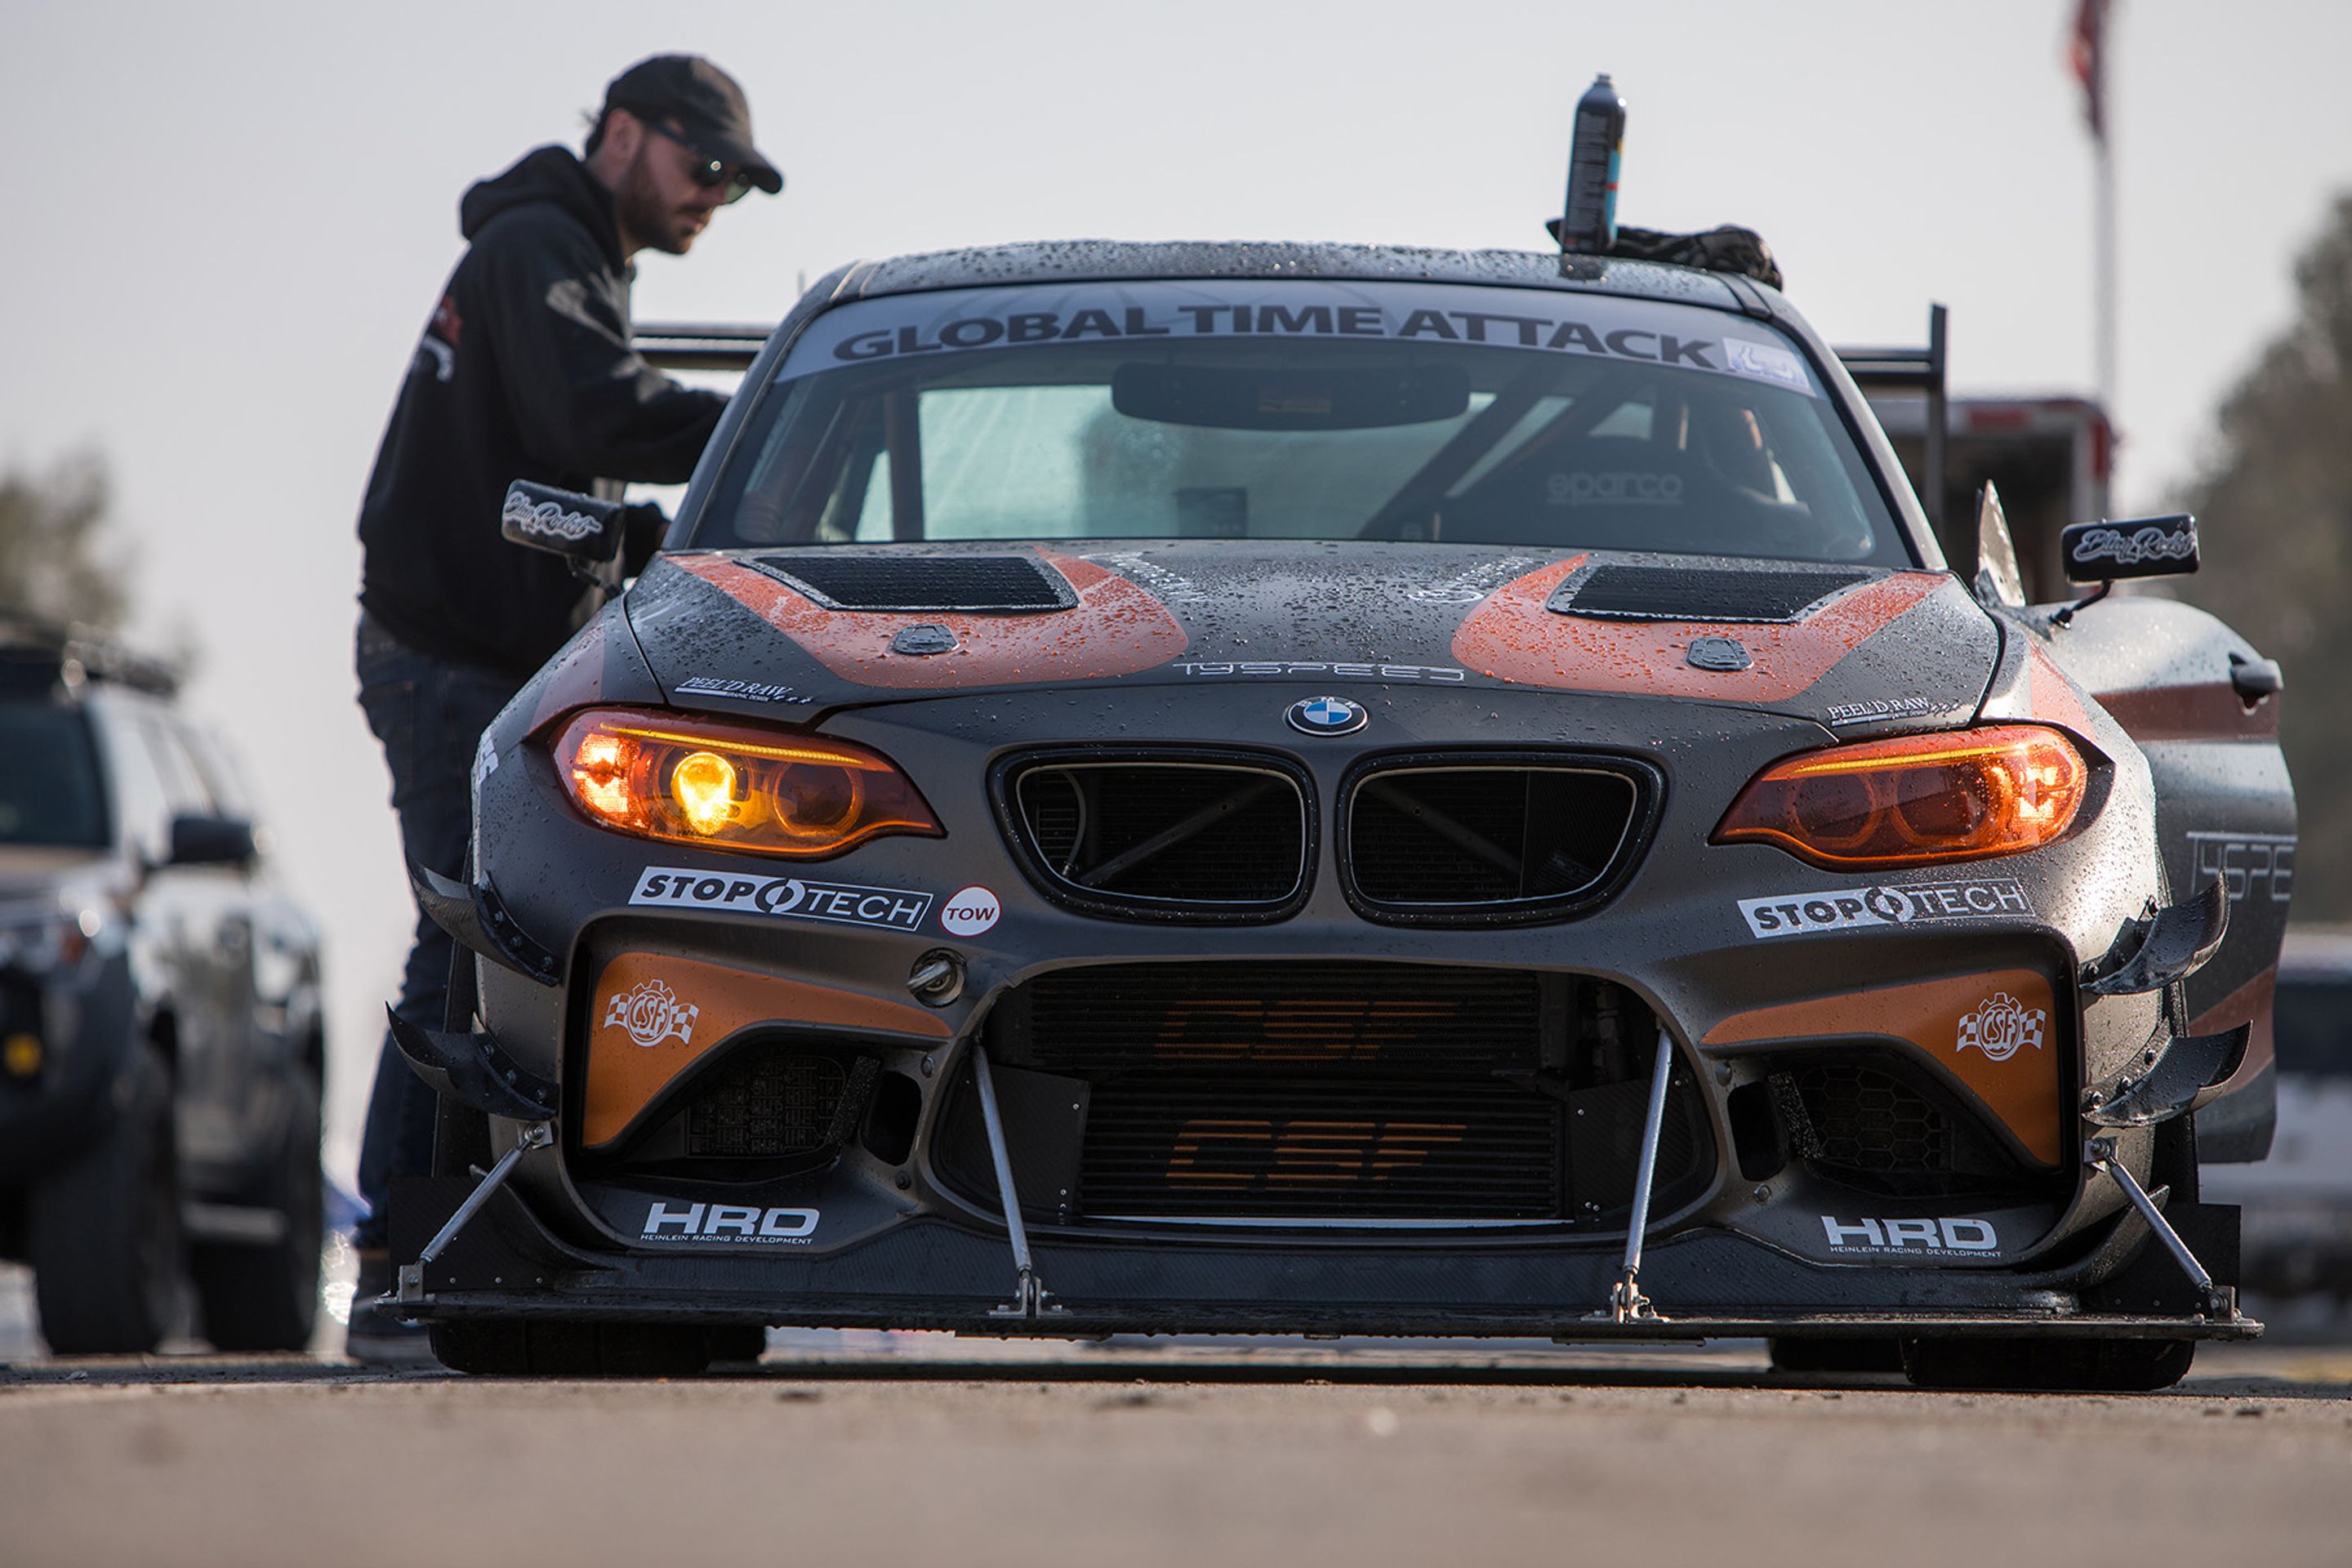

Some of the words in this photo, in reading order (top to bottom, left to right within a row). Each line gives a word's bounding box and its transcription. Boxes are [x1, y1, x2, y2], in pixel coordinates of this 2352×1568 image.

[833, 306, 1170, 361] GLOBAL
[1178, 305, 1385, 336] TIME
[1396, 309, 1722, 371] ATTACK
[742, 682, 794, 697] RAW
[1888, 697, 1931, 712] RAW
[947, 906, 996, 922] TOW
[643, 1202, 820, 1237] HRD
[640, 1234, 688, 1242] HEINLEIN
[693, 1235, 731, 1243] RACING
[734, 1236, 813, 1245] DEVELOPMENT
[1820, 1215, 1998, 1250] HRD
[1926, 1249, 2002, 1258] DEVELOPMENT
